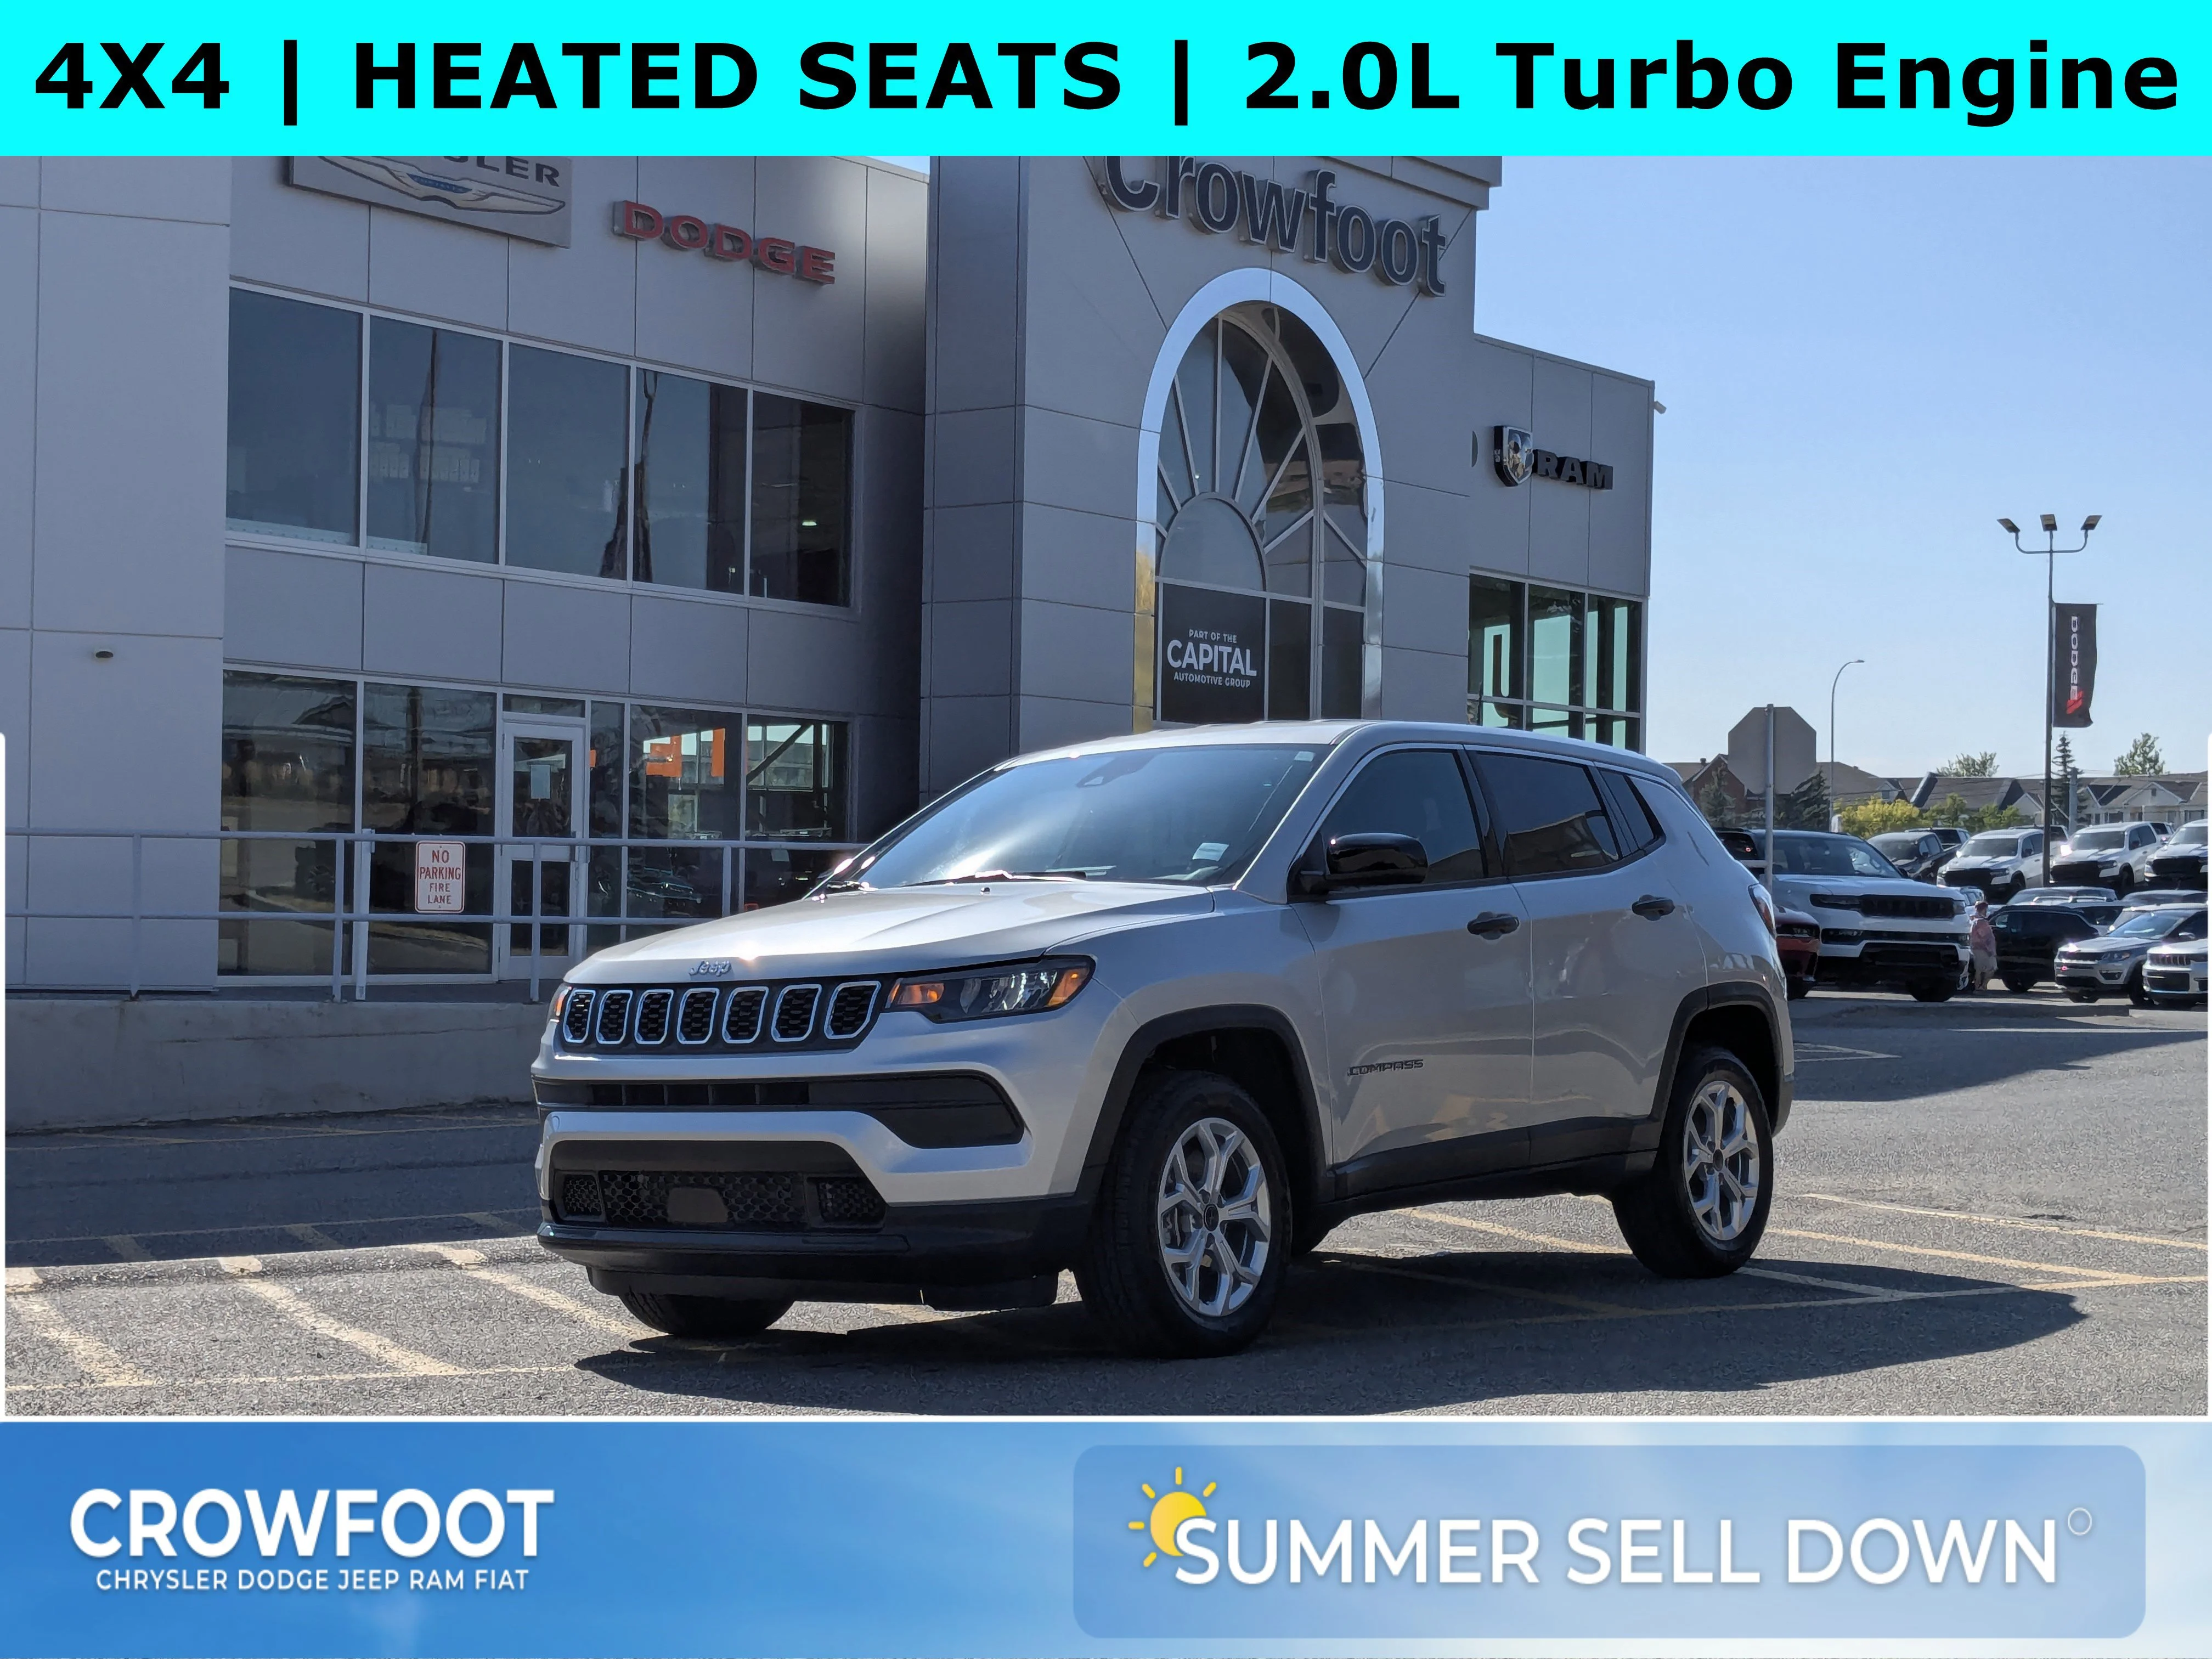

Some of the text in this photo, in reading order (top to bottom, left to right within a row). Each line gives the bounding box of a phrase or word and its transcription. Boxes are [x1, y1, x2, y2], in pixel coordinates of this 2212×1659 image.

[1103, 156, 1447, 297] Crowfoot
[614, 200, 836, 285] DODGE
[1534, 449, 1613, 490] RAM
[1189, 629, 1237, 643] PART OF THE
[1167, 639, 1257, 676] CAPITAL
[2069, 616, 2079, 701] DODGE
[1173, 672, 1251, 689] AUTOMOTIVE GROUP
[432, 850, 449, 864] NO
[419, 866, 461, 880] PARKING
[430, 883, 450, 892] FIRE
[427, 895, 452, 904] LANE
[689, 961, 732, 977] Jeep
[1347, 1059, 1424, 1077] COMPASS
